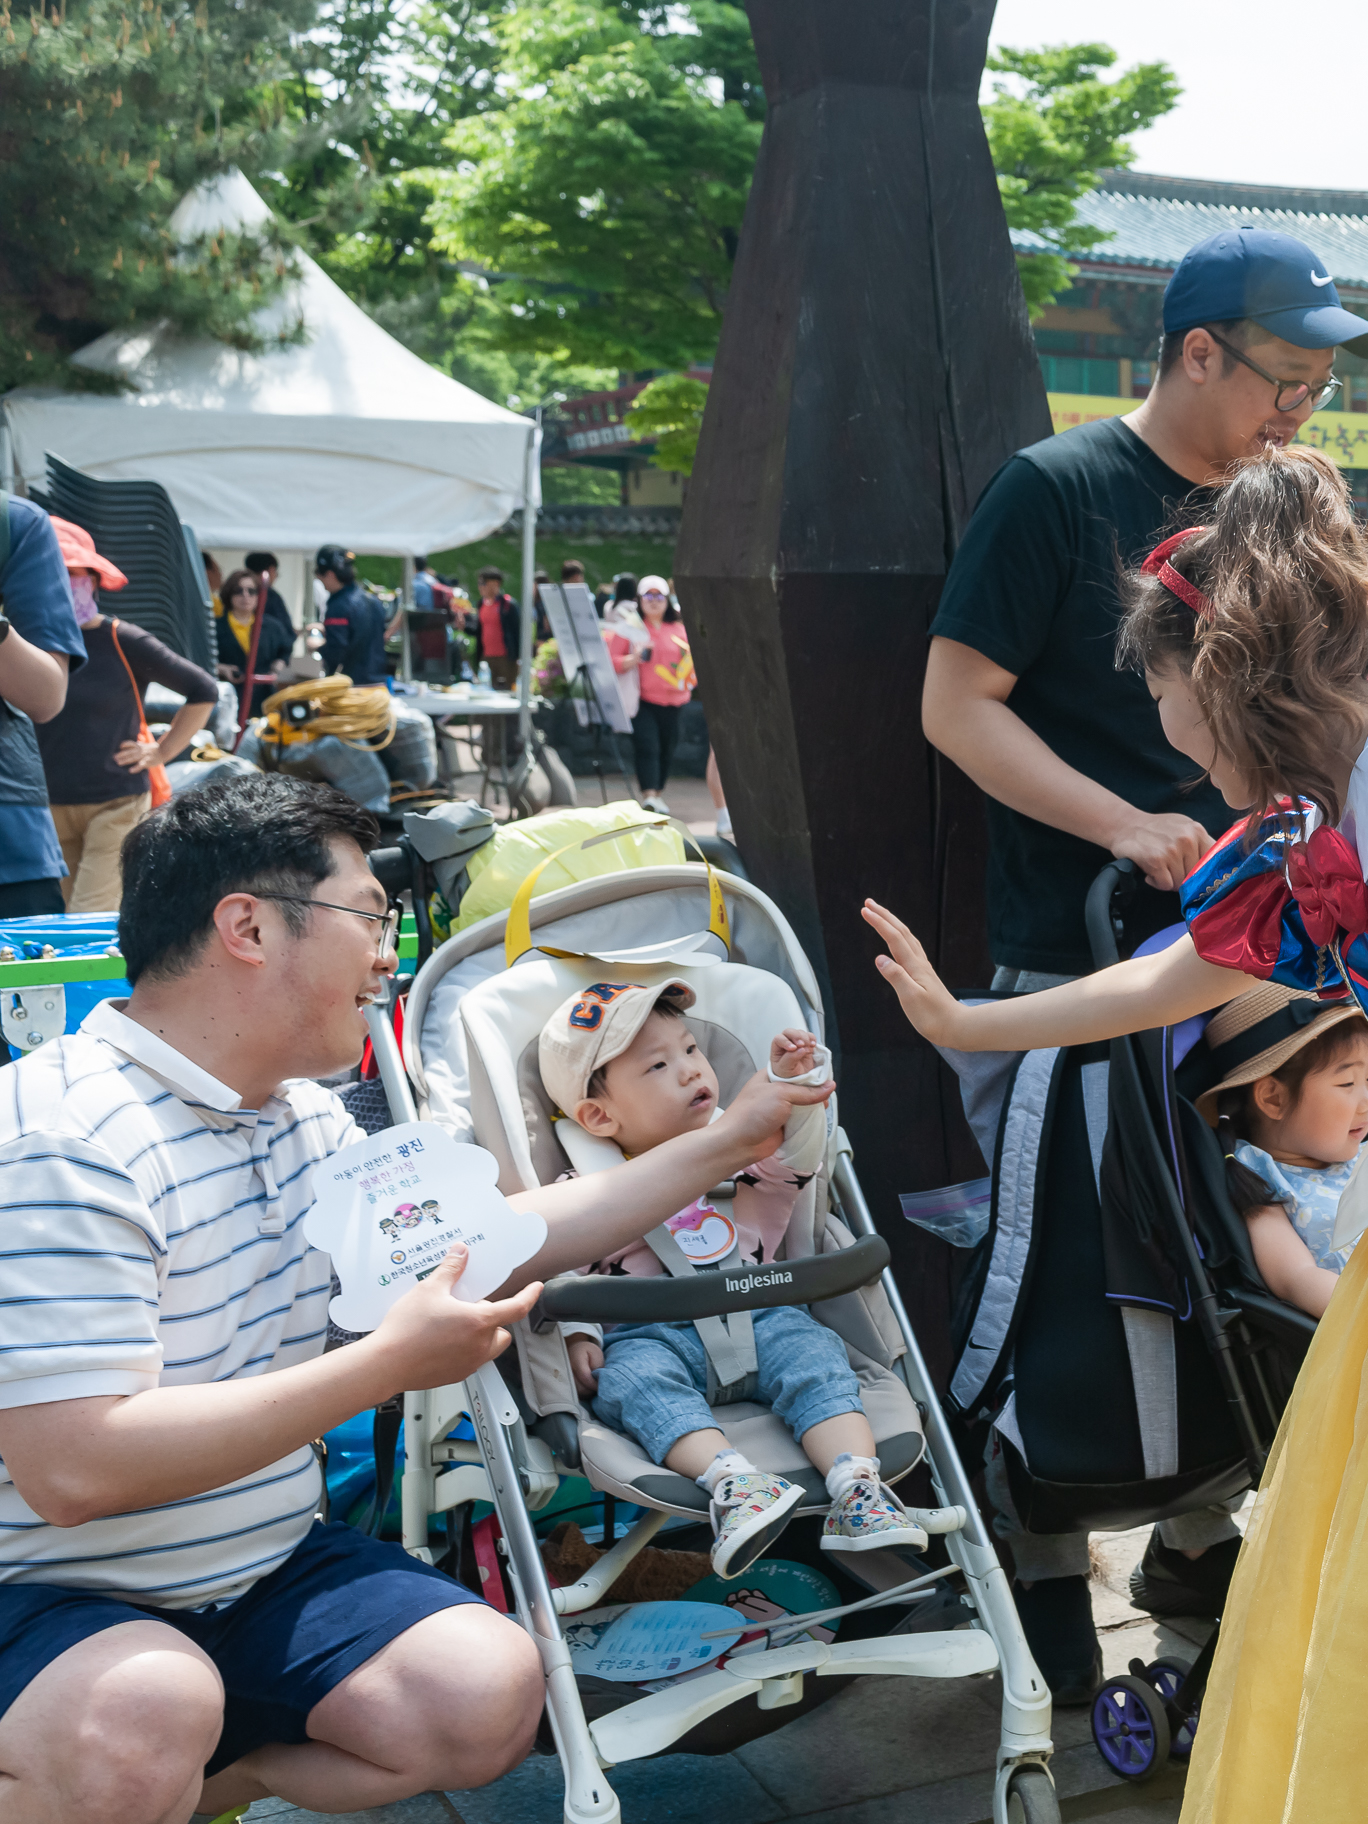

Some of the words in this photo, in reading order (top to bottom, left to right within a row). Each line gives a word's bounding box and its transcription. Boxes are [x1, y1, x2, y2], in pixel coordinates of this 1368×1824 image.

[568, 982, 648, 1032] CA
[333, 1164, 363, 1181] 아동이
[363, 1153, 393, 1171] 안전한
[395, 1138, 426, 1158] 광진
[358, 1170, 393, 1191] 행복한
[392, 1160, 416, 1175] 가정
[398, 1174, 422, 1189] 학교
[725, 1270, 793, 1294] Inglesina
